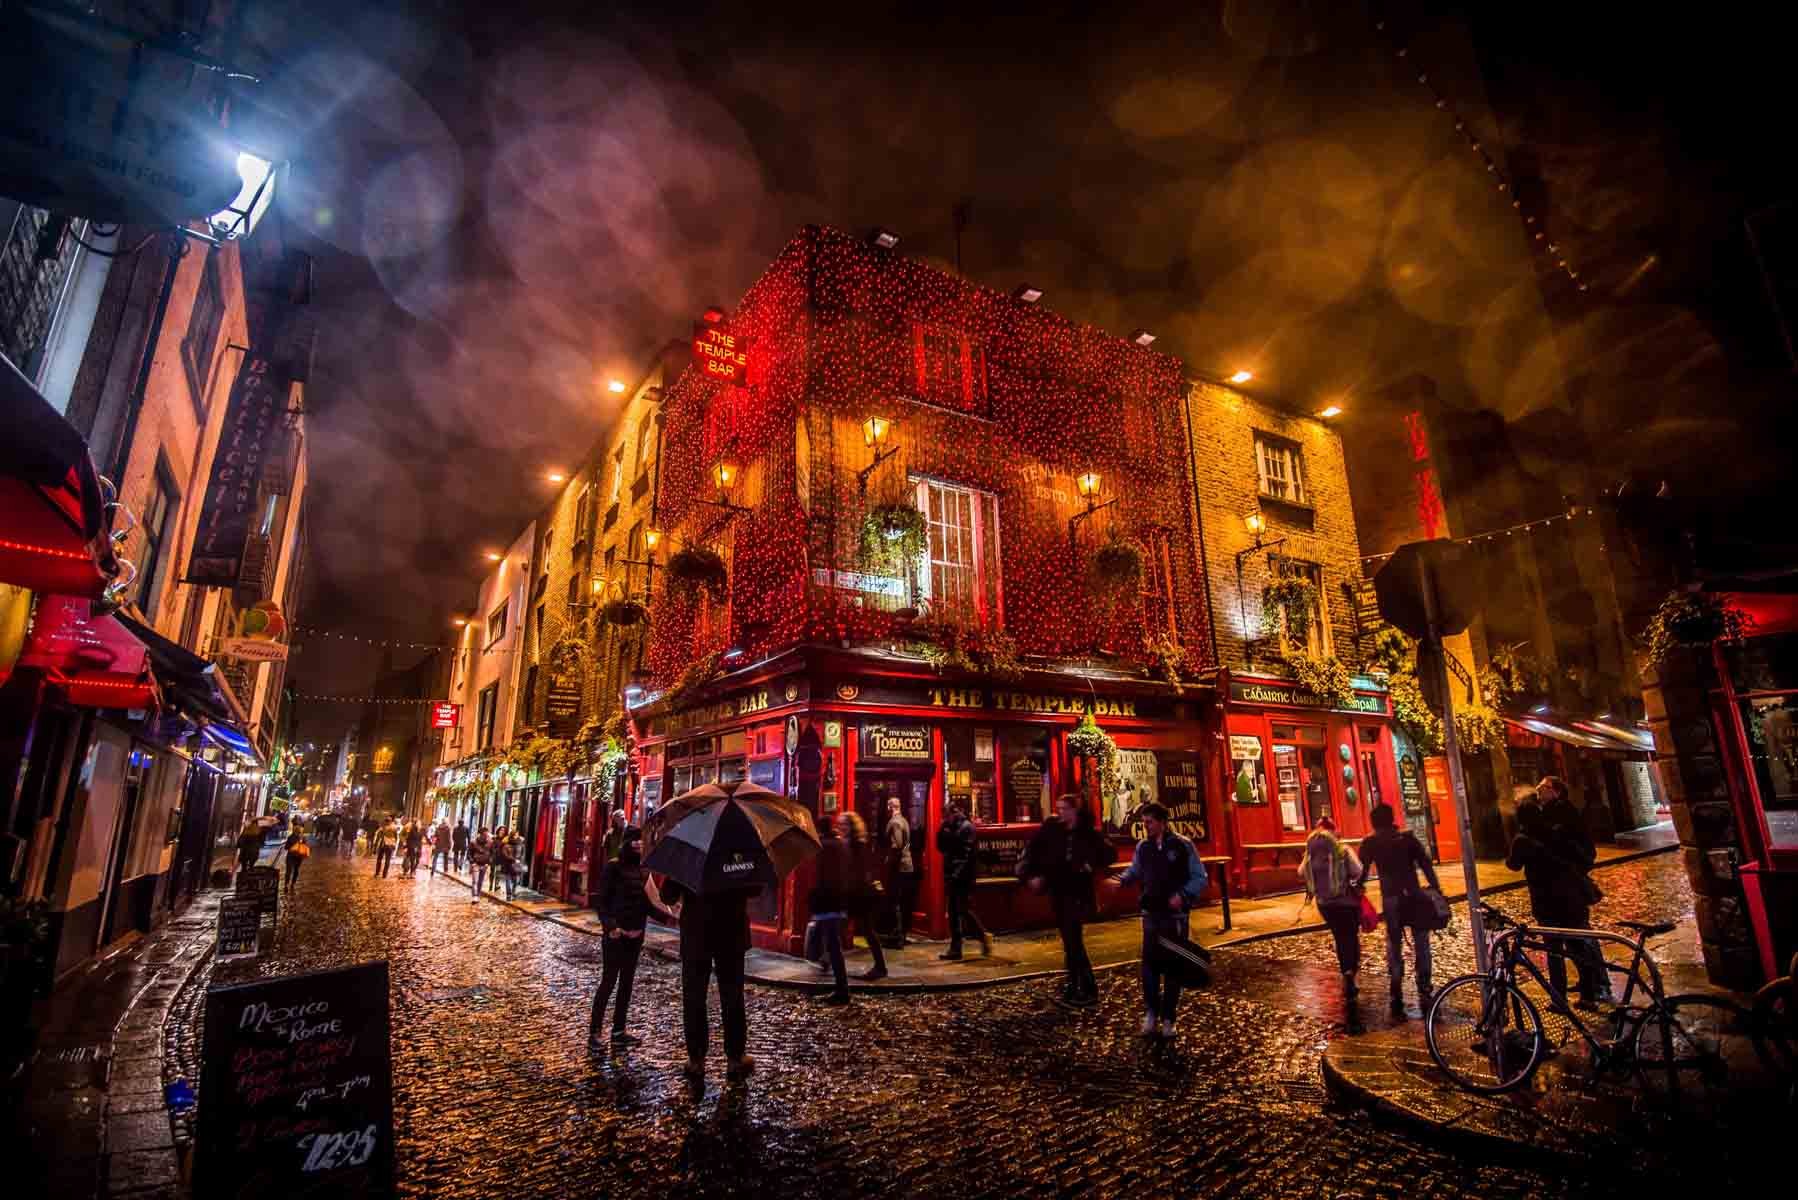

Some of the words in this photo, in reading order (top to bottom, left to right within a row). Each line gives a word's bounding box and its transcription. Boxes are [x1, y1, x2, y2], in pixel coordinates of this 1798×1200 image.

[708, 329, 736, 349] THE
[696, 340, 747, 366] TEMPLE
[709, 359, 736, 377] BAR
[737, 690, 769, 715] BAR
[927, 687, 983, 709] THE
[992, 692, 1085, 714] TEMPLE
[1094, 697, 1137, 717] BAR
[870, 733, 924, 755] TOBACCO
[1119, 752, 1157, 765] TEMPLE
[1130, 763, 1149, 775] BAR
[1130, 819, 1206, 841] GNESS
[722, 862, 755, 873] GUINNESS
[239, 1000, 329, 1033] Mexico
